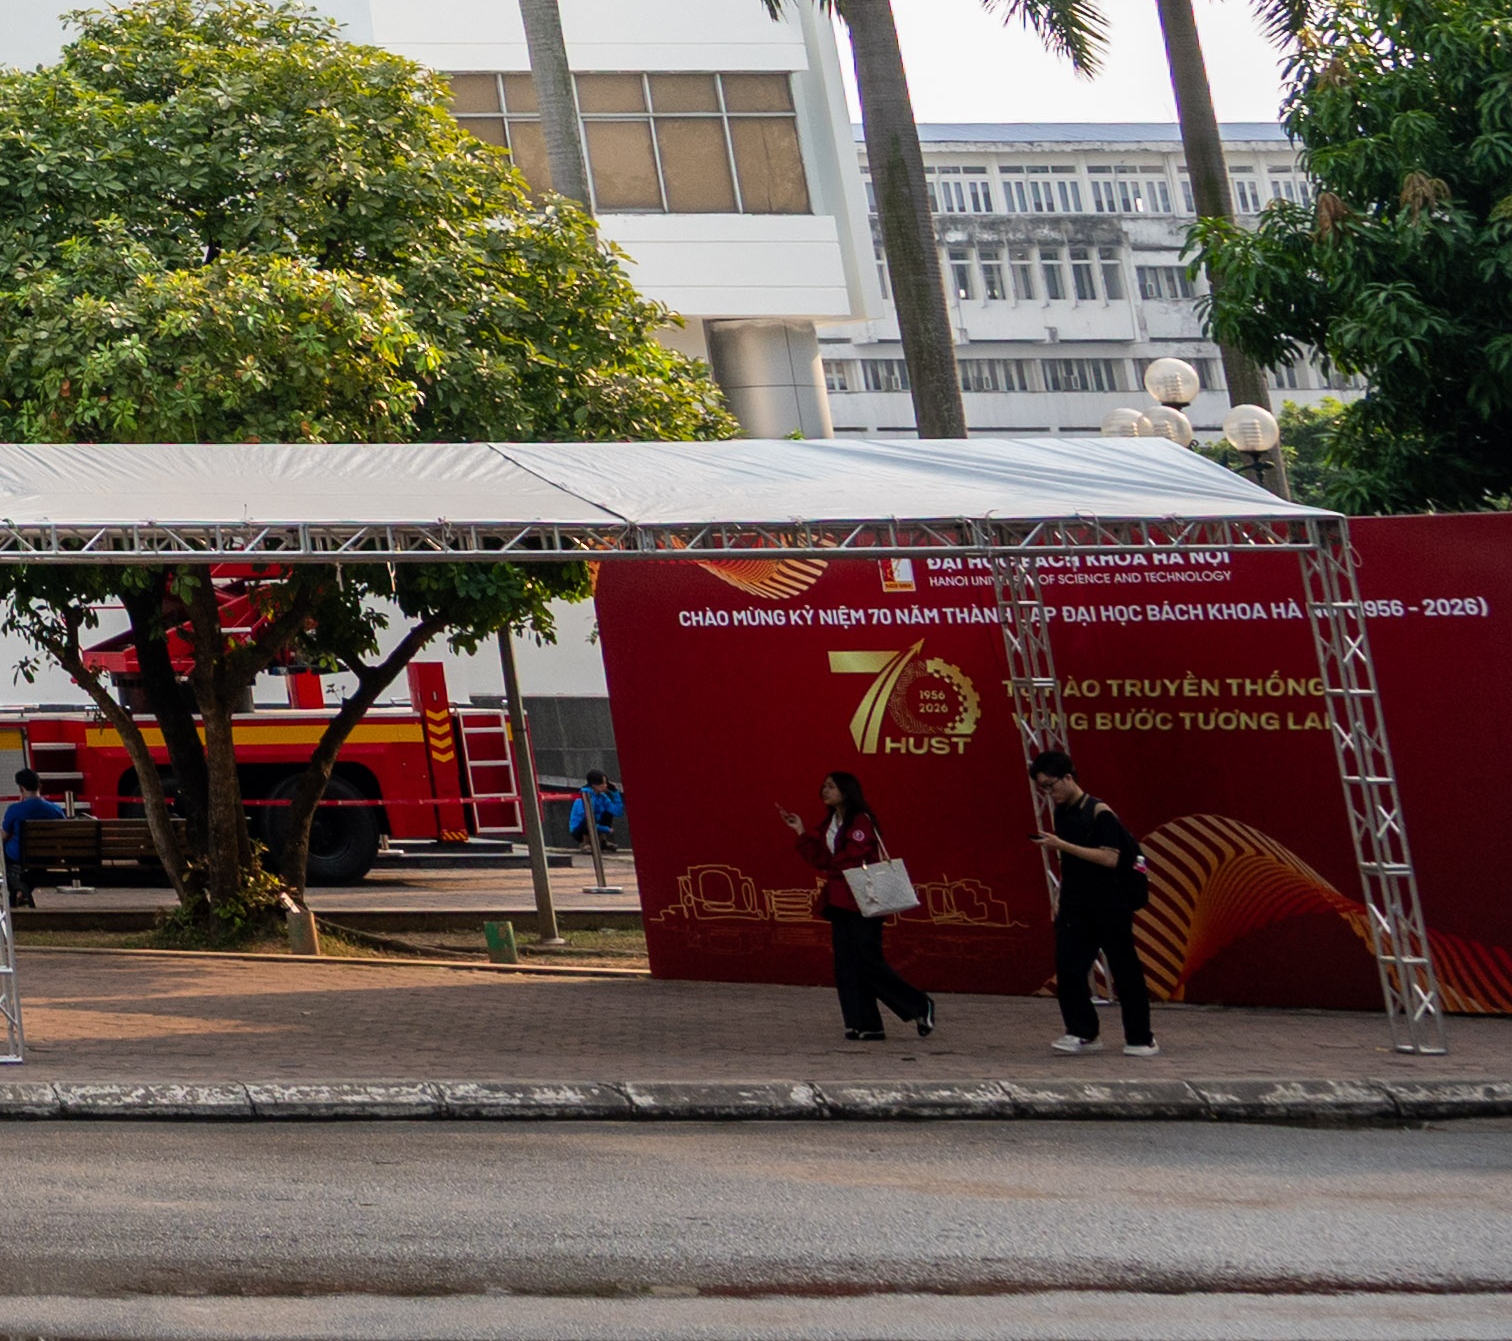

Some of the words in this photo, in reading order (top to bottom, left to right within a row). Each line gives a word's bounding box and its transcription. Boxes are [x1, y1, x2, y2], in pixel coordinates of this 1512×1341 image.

[928, 575, 968, 587] HANOI
[1038, 573, 1055, 586] OF
[1058, 572, 1111, 585] SCIENCE
[1114, 571, 1142, 584] AND
[1144, 569, 1232, 583] TECHNOLOGY
[678, 605, 730, 627] CHÀO
[731, 604, 786, 627] MỪNG
[789, 604, 814, 625] KỶ
[819, 605, 865, 629] NIỆM
[868, 608, 892, 625] 70
[895, 606, 940, 625] NĂM
[1061, 605, 1097, 627] ĐẠI
[1100, 604, 1143, 627] HỌC
[1146, 600, 1204, 622] BÁCH
[1207, 602, 1269, 621] KHOA
[1270, 597, 1304, 620] HÀ
[1422, 595, 1489, 618] 2026)
[1106, 669, 1220, 698] TRUYỀN
[1225, 669, 1326, 697] THỐNG
[919, 689, 946, 700] 1956
[918, 702, 949, 713] 2026
[1095, 707, 1173, 731] BƯỚC
[1178, 708, 1281, 731] TƯƠNG
[1287, 711, 1332, 730] LAI
[884, 736, 972, 755] HUST
